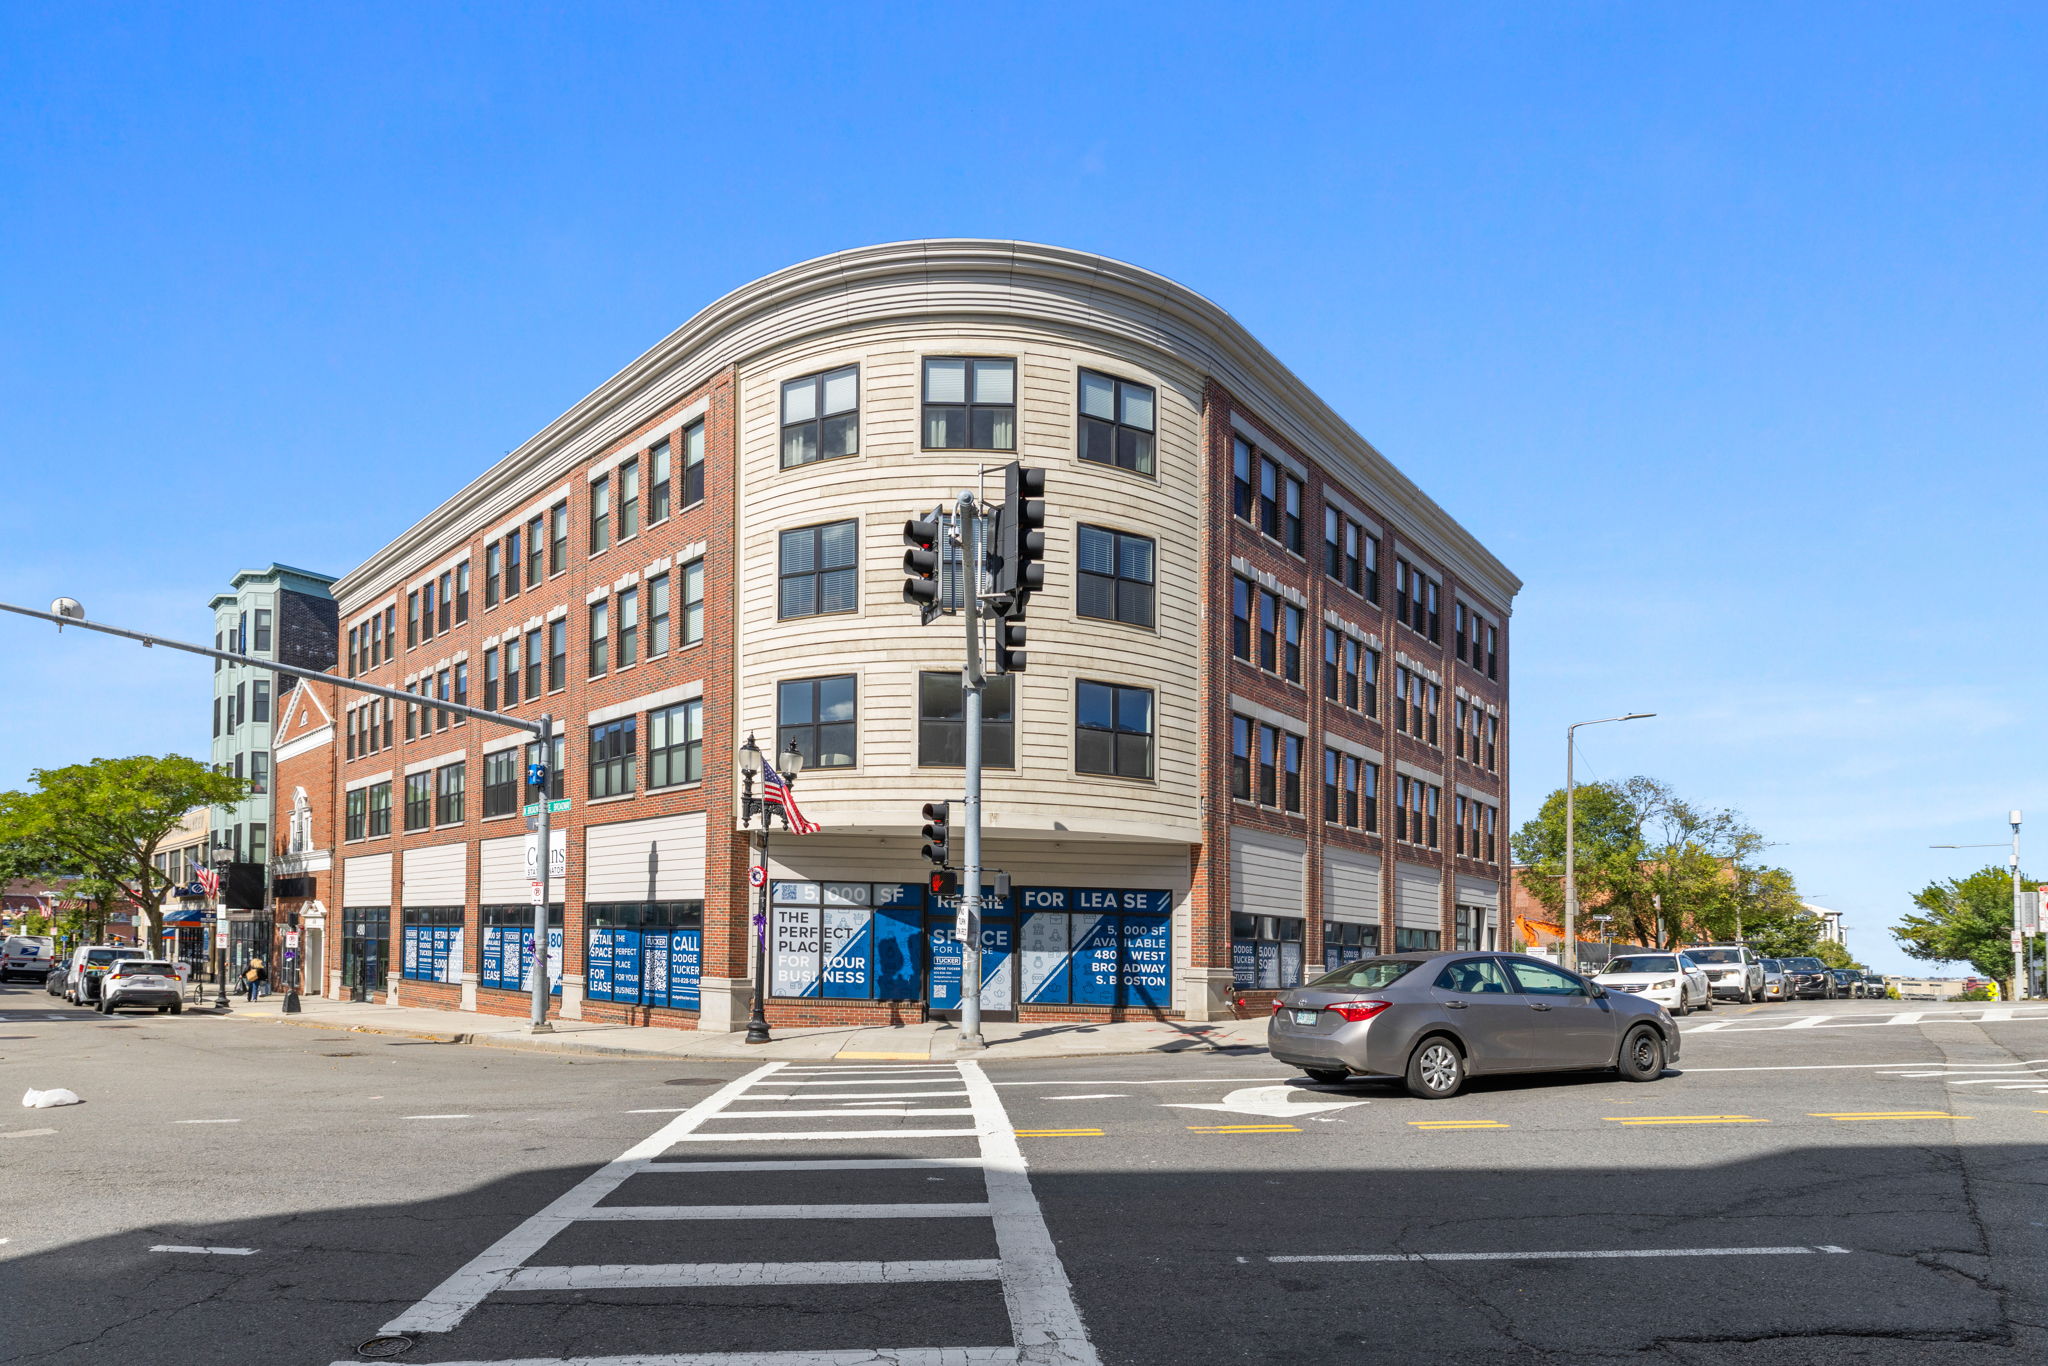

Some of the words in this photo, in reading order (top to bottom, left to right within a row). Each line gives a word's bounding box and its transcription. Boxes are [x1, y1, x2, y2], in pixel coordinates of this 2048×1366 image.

[803, 885, 866, 903] 5,000
[880, 887, 904, 902] SF
[937, 893, 1004, 909] REAIL
[1025, 891, 1064, 906] FOR
[1080, 892, 1147, 909] LEASE
[779, 911, 809, 923] THE
[420, 931, 432, 940] CALL
[779, 926, 853, 939] PERFECT
[1107, 925, 1147, 936] 5,000
[1151, 927, 1166, 936] SF
[547, 933, 562, 947] 80
[646, 938, 666, 946] TUCKER
[933, 929, 1008, 946] SPCE
[434, 941, 444, 949] FOR
[673, 936, 699, 951] CALL
[779, 941, 832, 953] PLACE
[1093, 938, 1166, 949] AVAILABLE
[590, 947, 612, 958] SPACE
[615, 948, 637, 956] PERFECT
[933, 946, 952, 954] FOR
[956, 947, 993, 955] LSE
[1234, 945, 1252, 953] DODGE
[1259, 947, 1276, 957] 5,000
[673, 954, 697, 963] DODGE
[1094, 951, 1117, 960] 480
[1131, 952, 1166, 961] WEST
[484, 959, 496, 969] FOR
[615, 961, 631, 969] PLACE
[778, 955, 809, 968] FOR
[823, 957, 866, 969] YOUR
[673, 965, 700, 975] TUCKER
[1092, 963, 1166, 973] BROADWAY
[484, 971, 501, 980] LEASE
[590, 969, 605, 980] FOR
[625, 974, 639, 982] YOUR
[778, 970, 865, 984] BUSINESS
[1096, 976, 1106, 985] S.
[1109, 976, 1166, 986] BOSTON
[590, 981, 612, 992] LEASE
[615, 986, 638, 995] BUSINESS
